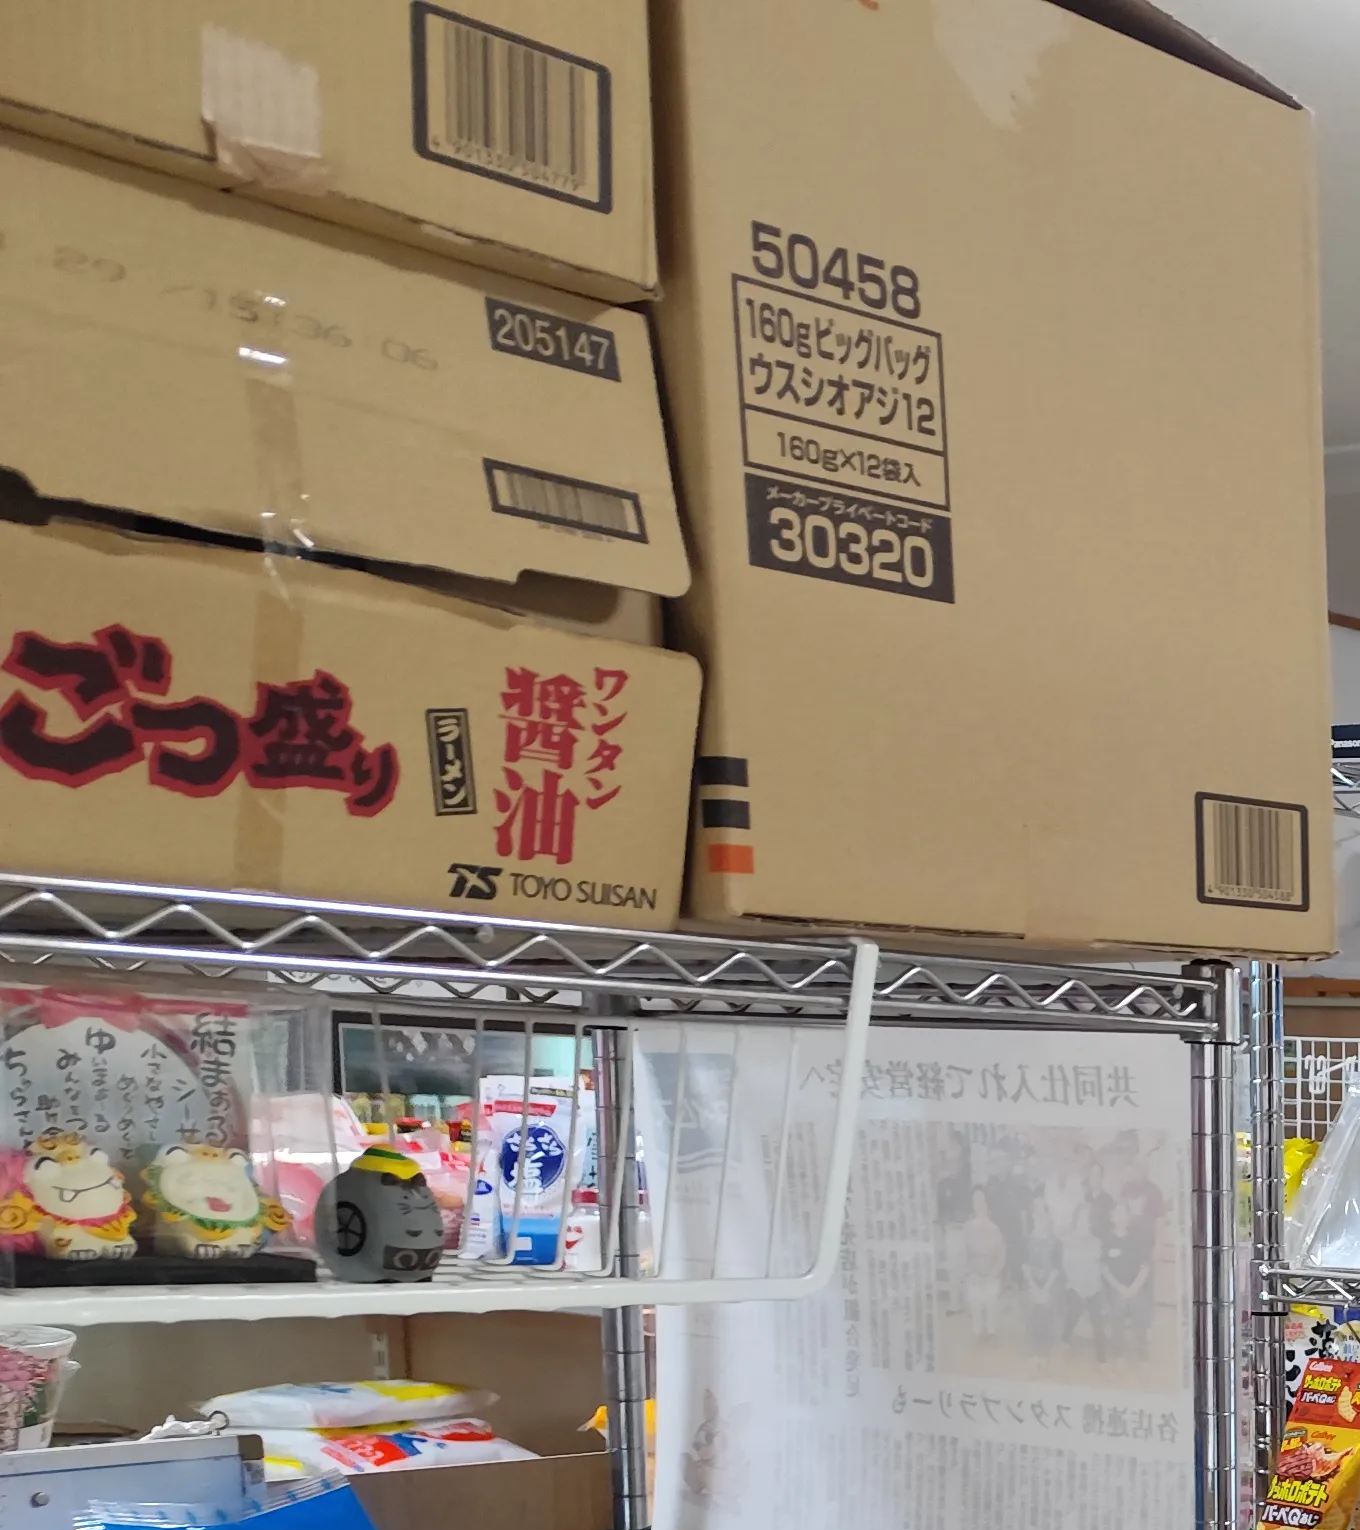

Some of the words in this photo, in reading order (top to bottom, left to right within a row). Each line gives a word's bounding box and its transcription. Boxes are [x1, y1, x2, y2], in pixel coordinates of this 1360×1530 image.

[751, 219, 921, 320] 50458
[494, 307, 609, 367] 205147
[745, 298, 931, 385] 160gビッグバッグ
[749, 352, 936, 437] ウスシオアジ12
[776, 431, 922, 488] 160g×12袋入
[769, 507, 934, 589] 30320
[3, 624, 398, 817] ごつ盛り
[436, 717, 466, 805] ラーメン
[584, 667, 630, 810] ワンタン
[493, 666, 587, 865] 醤油
[509, 872, 572, 902] TOYO
[576, 880, 658, 911] SUISAN
[1260, 1503, 1324, 1530] バーベQあじ
[1267, 1475, 1329, 1506] サッポロポテト
